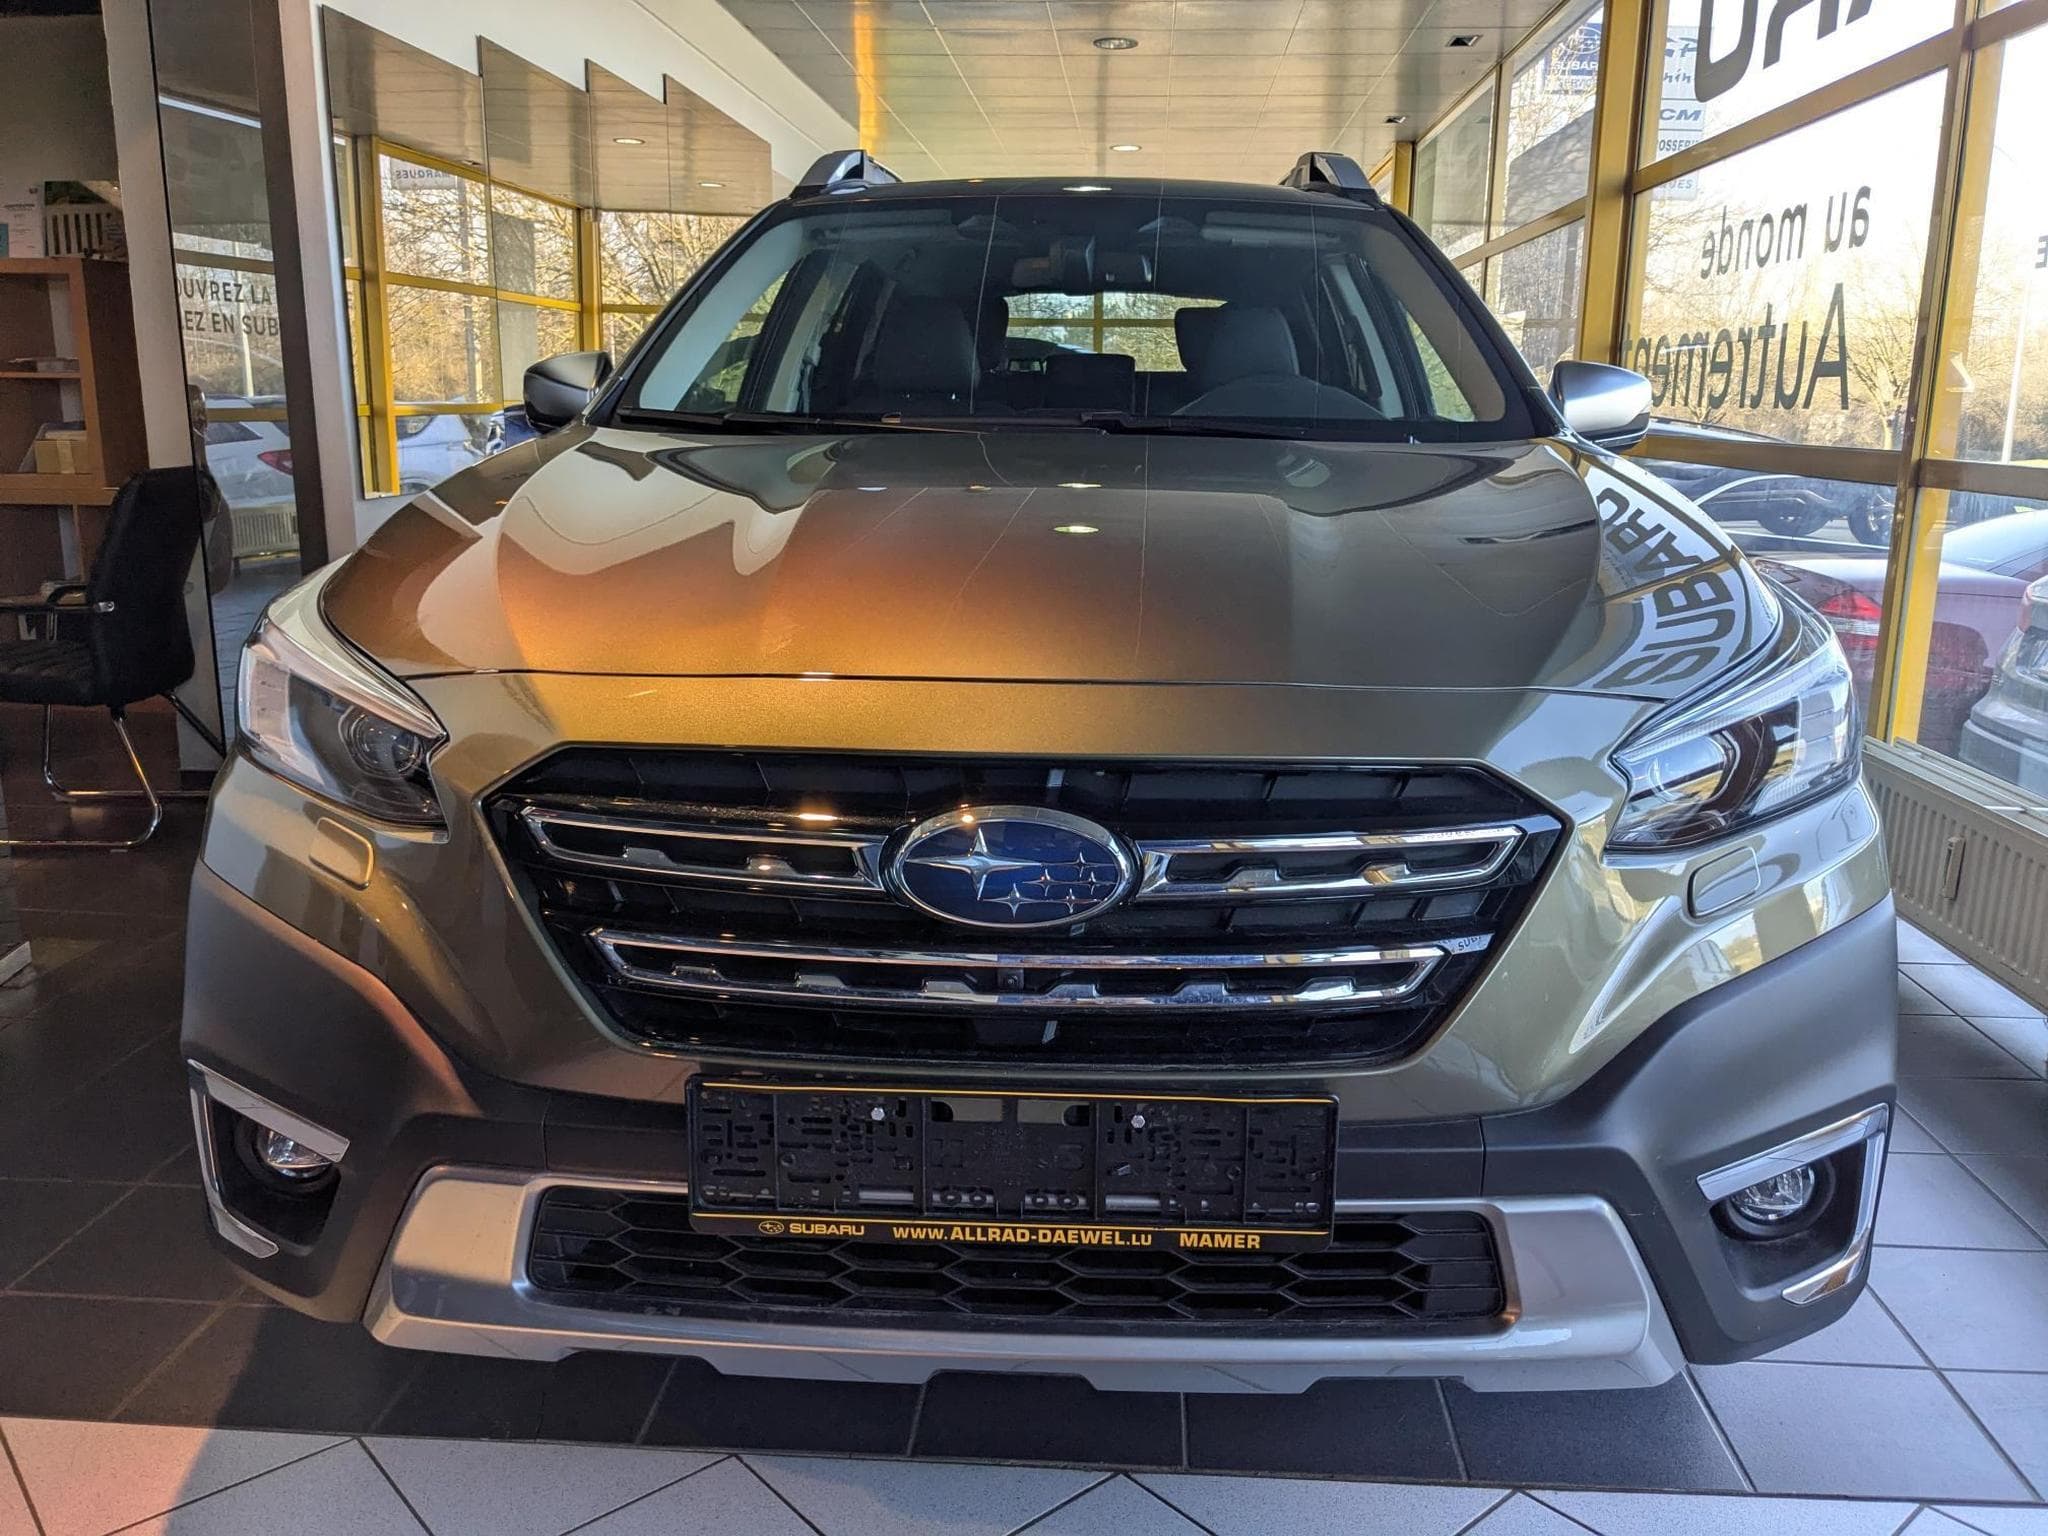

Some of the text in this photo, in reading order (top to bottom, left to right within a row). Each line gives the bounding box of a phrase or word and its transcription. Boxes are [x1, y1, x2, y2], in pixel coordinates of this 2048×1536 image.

[1658, 138, 1700, 152] OSSER
[250, 284, 272, 305] LA
[182, 310, 206, 332] EZ
[211, 312, 236, 334] EN
[789, 1222, 865, 1237] SUBARU
[1179, 1232, 1261, 1250] MAMER
